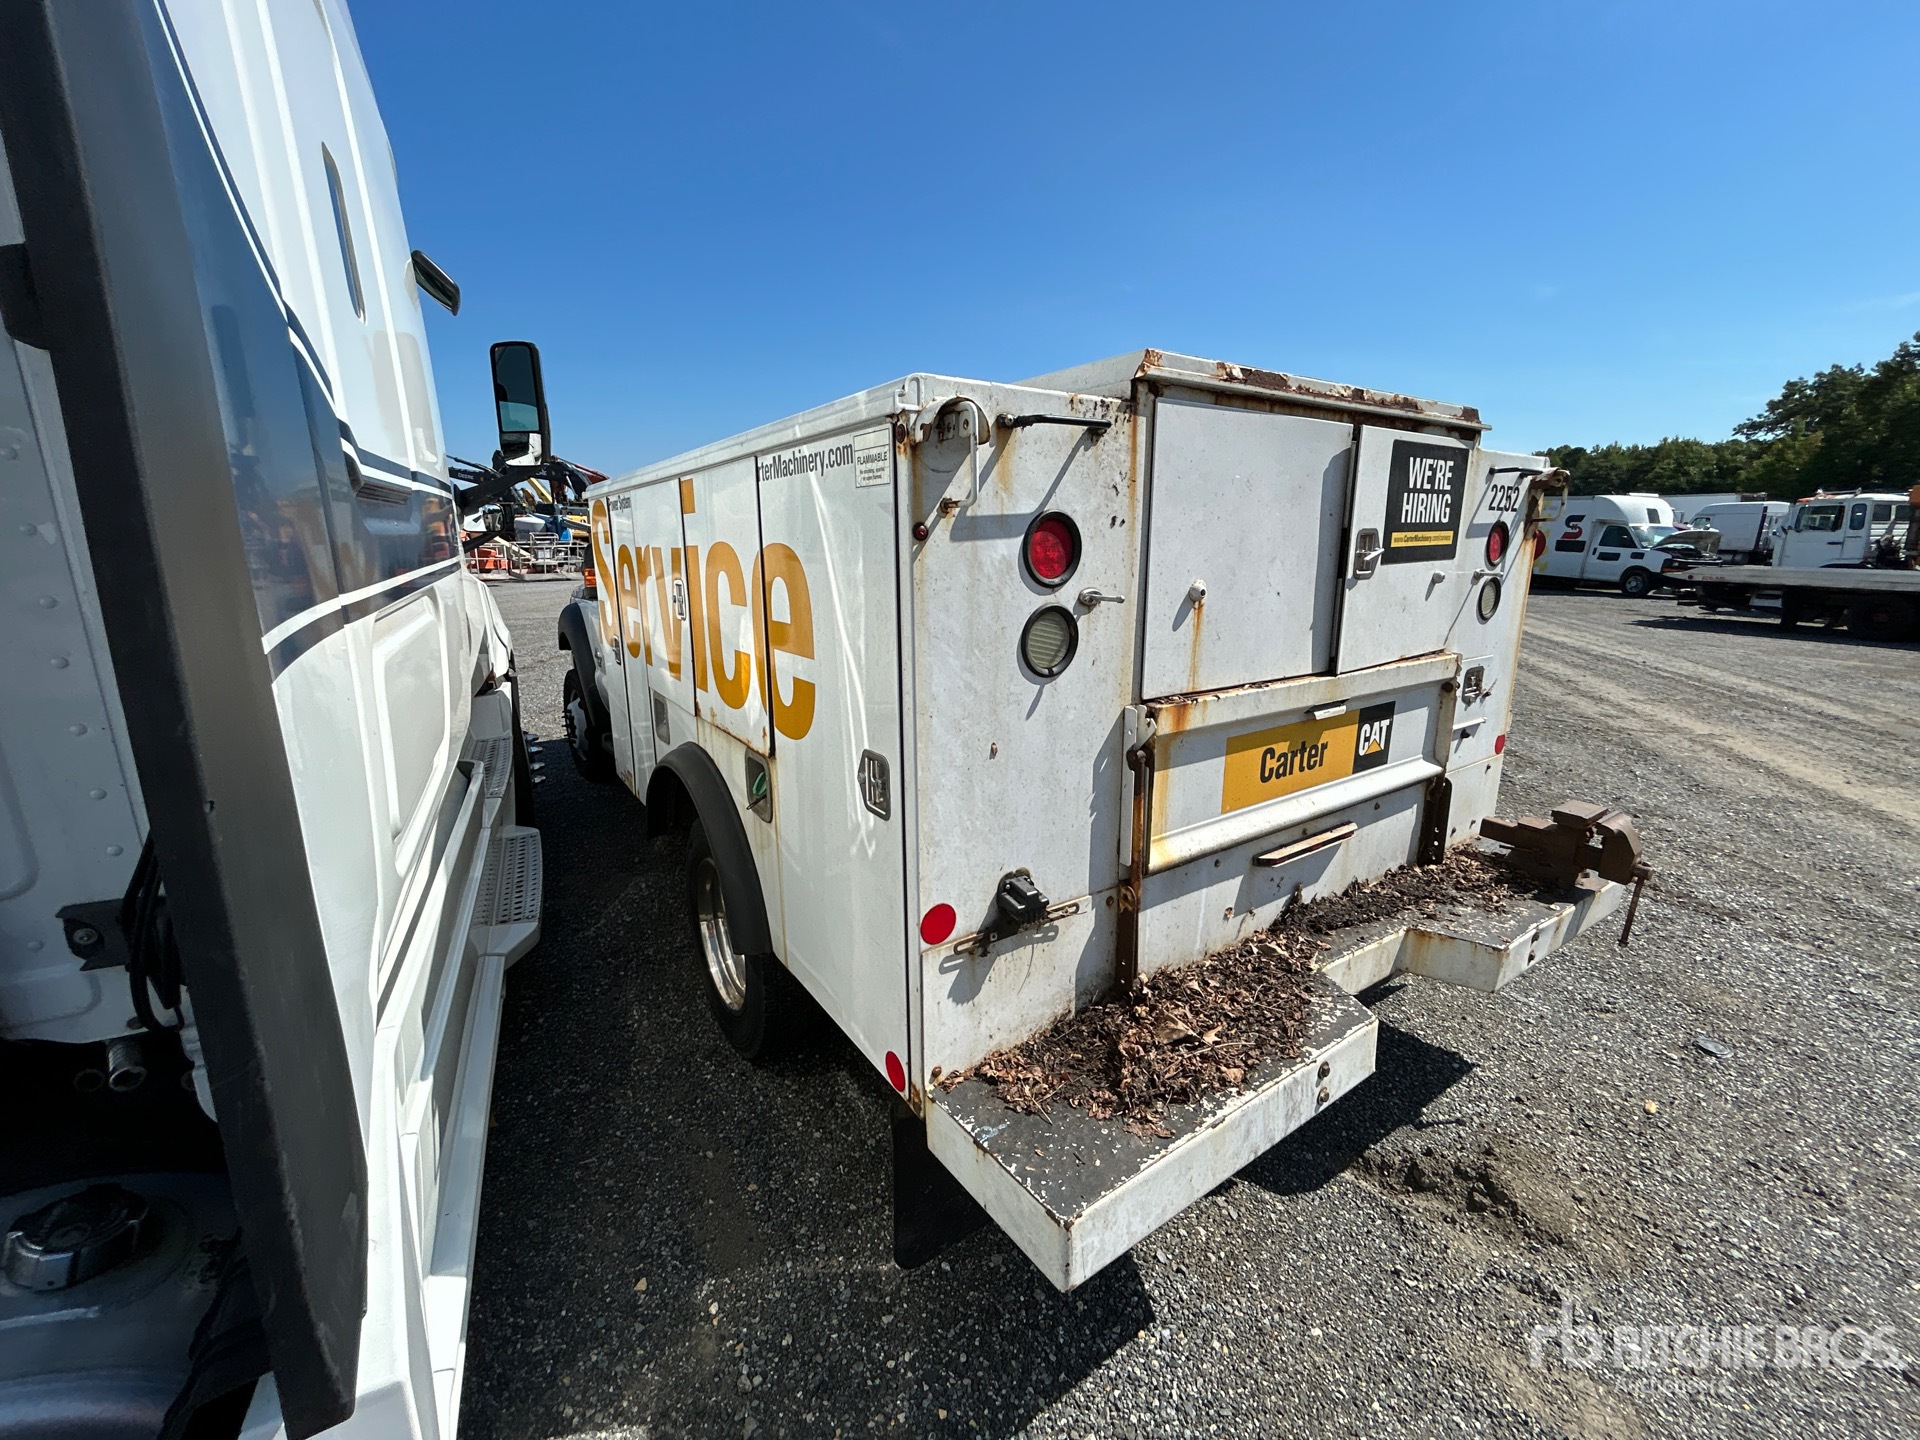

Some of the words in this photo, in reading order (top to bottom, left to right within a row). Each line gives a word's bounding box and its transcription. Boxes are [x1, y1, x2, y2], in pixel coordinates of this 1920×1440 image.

[857, 451, 887, 465] FLAMMABLE
[1409, 457, 1454, 490] WE'RE
[1401, 492, 1451, 524] HIRING
[1488, 484, 1520, 512] 2252
[592, 478, 816, 740] Service
[1358, 718, 1390, 757] CAT
[1260, 740, 1328, 784] Carter
